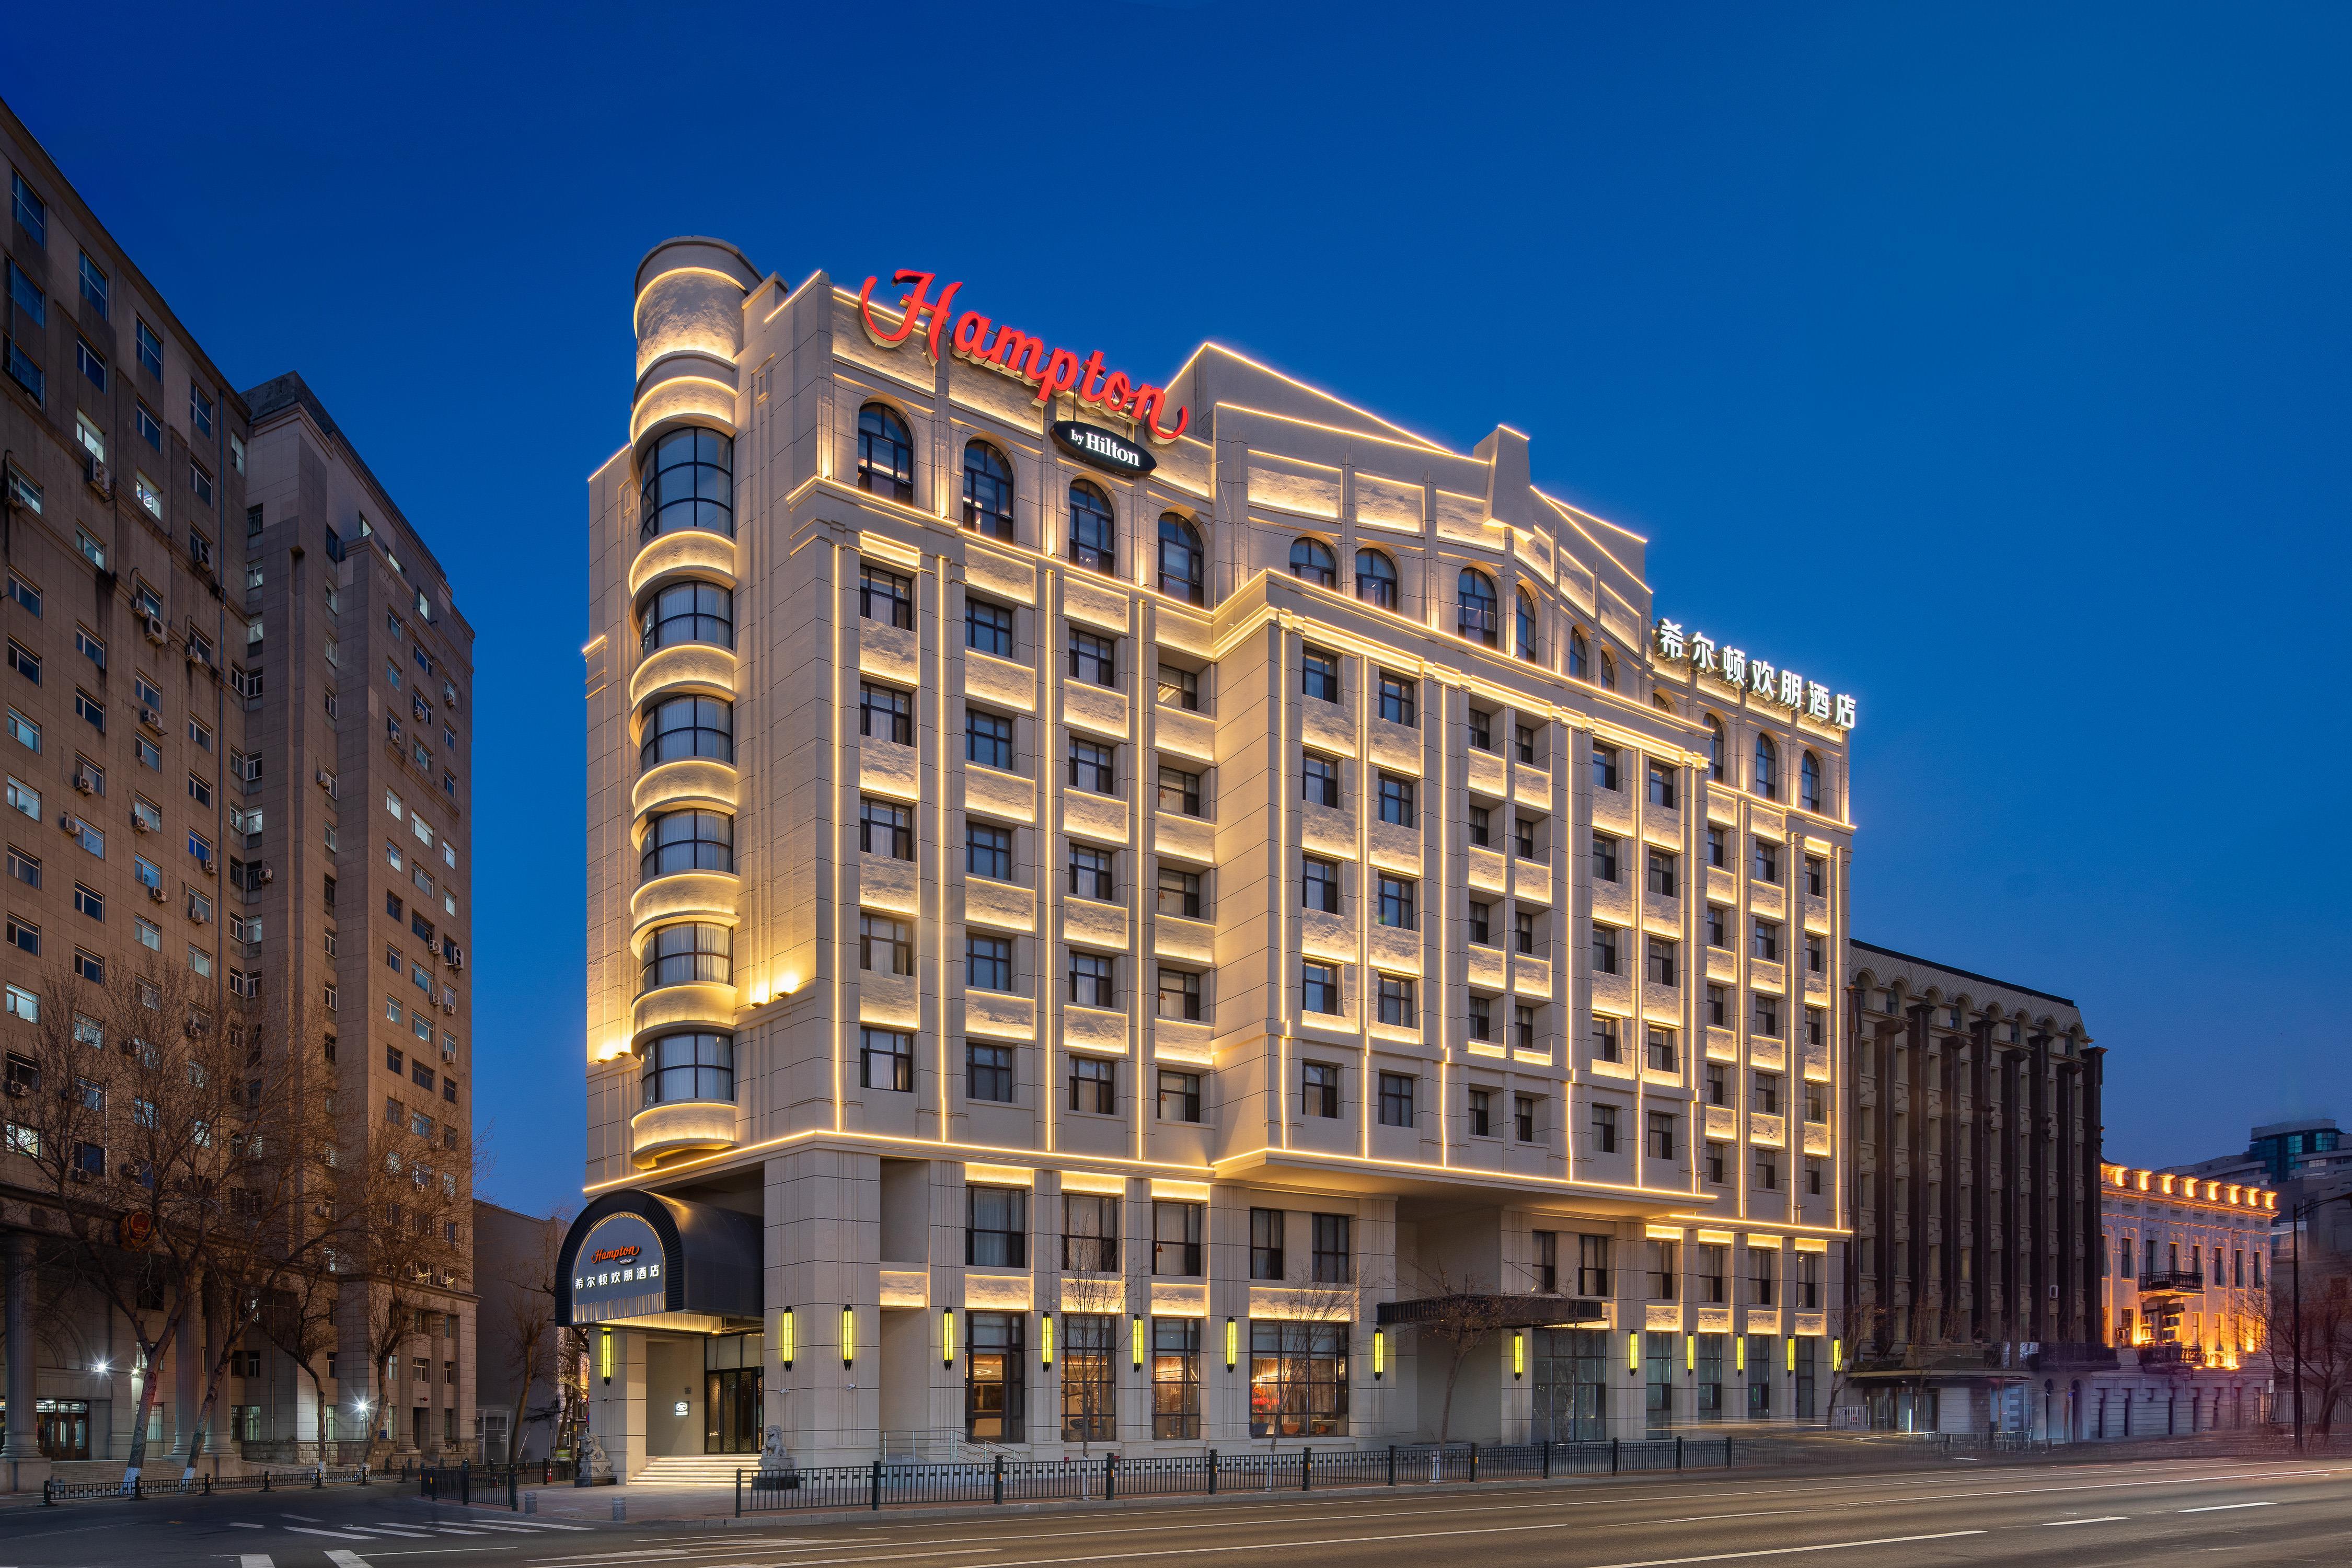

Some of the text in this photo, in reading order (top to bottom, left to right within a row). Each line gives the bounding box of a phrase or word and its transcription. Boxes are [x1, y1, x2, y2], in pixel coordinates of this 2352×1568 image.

[861, 269, 1189, 440] Hampton
[1071, 429, 1140, 467] by Hilton
[1659, 618, 1857, 729] 希尔顿欢朋酒店
[591, 1246, 640, 1263] Hampton
[575, 1264, 660, 1289] 希尔顿欢朋酒店
